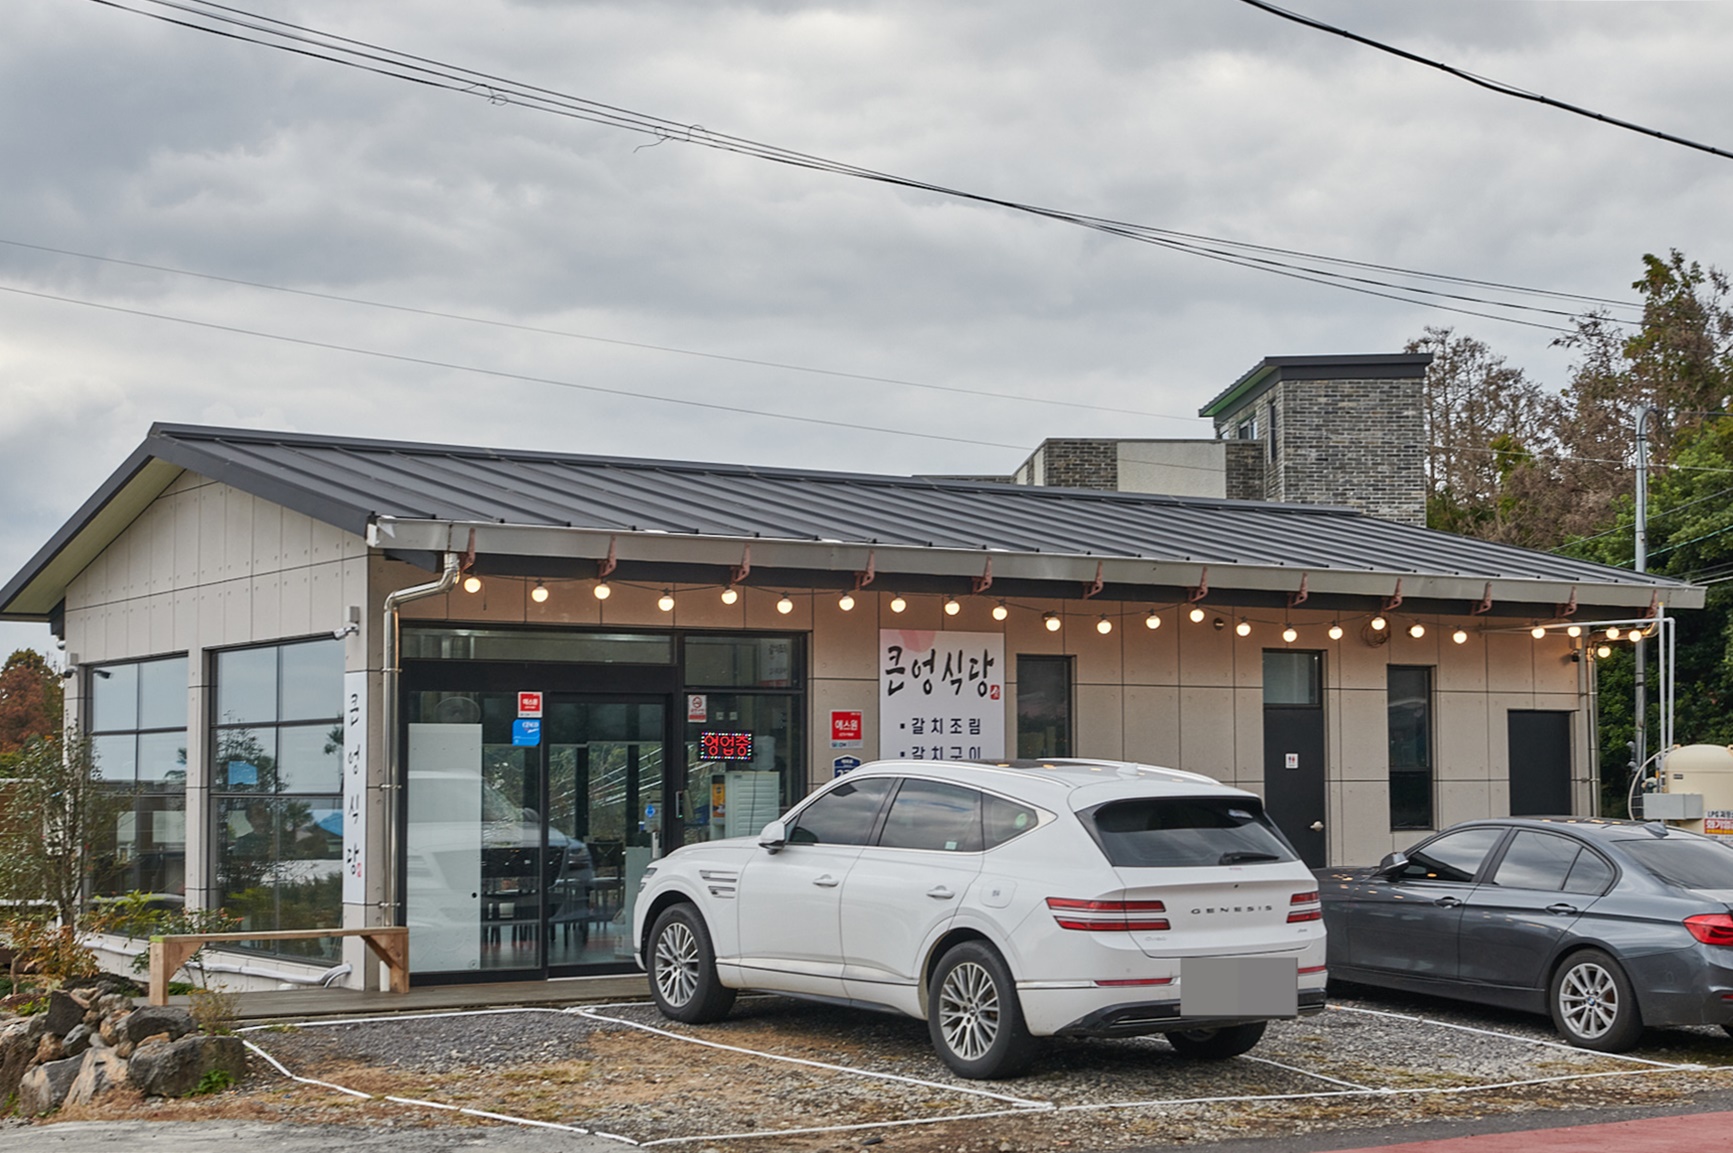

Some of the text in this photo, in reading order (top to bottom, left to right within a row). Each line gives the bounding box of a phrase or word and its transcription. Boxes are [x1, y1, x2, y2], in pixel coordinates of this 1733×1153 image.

[834, 719, 858, 731] 에스원
[911, 717, 981, 735] 갈치조림
[704, 735, 749, 756] 영업중
[1190, 905, 1273, 915] GENESIS
